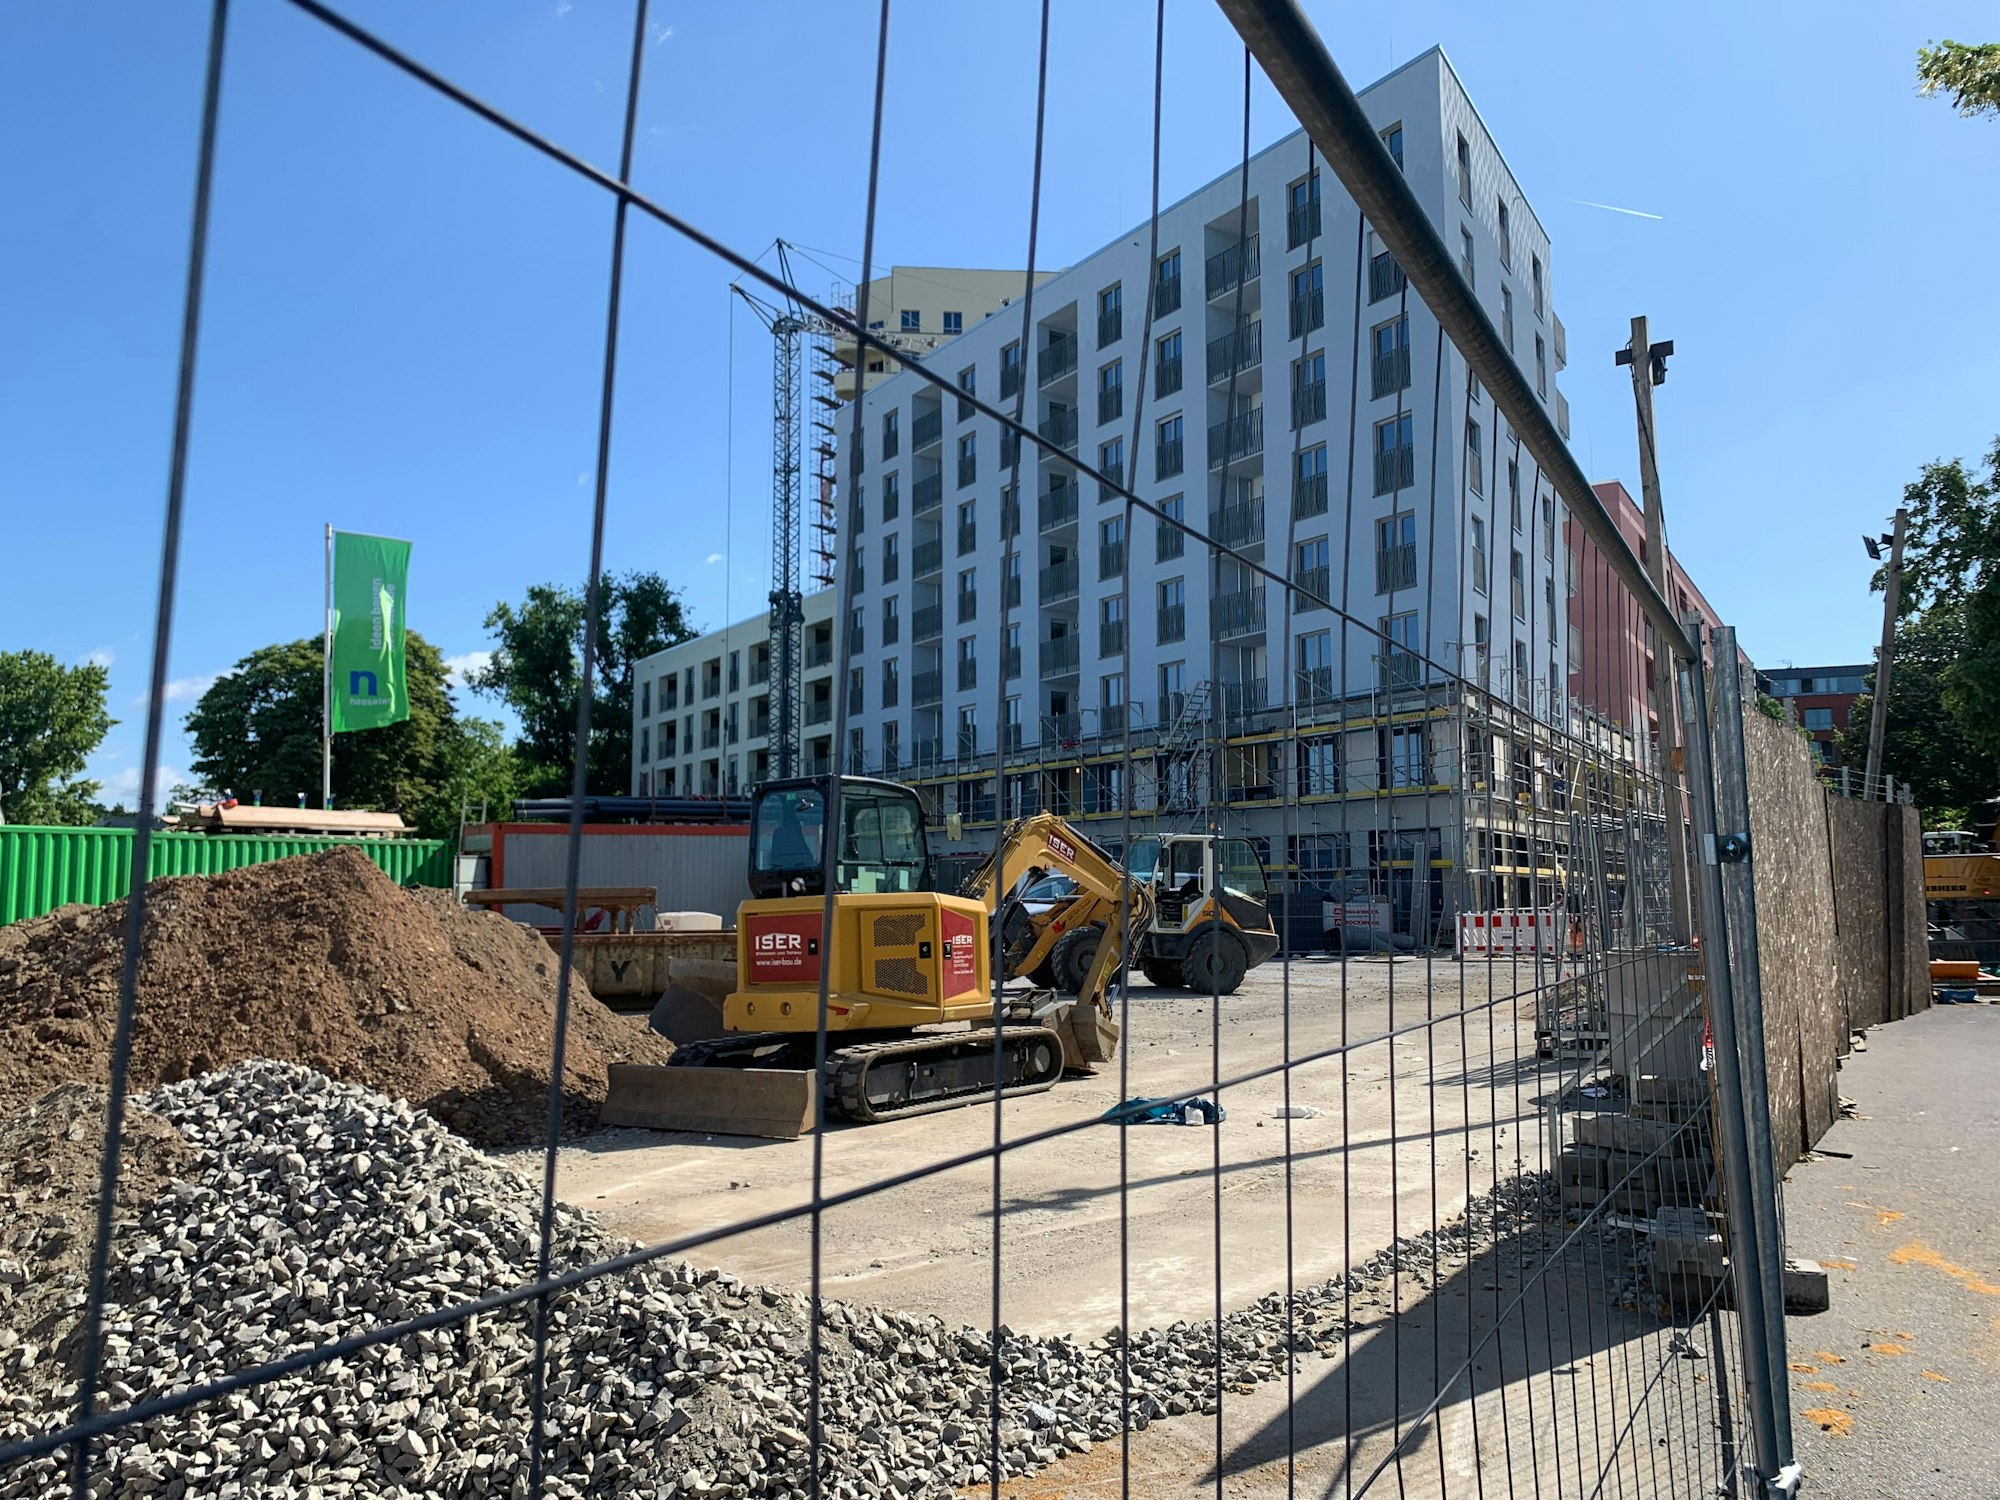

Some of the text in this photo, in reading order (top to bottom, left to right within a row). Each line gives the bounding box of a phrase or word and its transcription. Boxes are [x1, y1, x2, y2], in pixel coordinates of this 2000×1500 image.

[350, 670, 377, 697] n
[1048, 834, 1075, 860] ISER
[755, 933, 801, 950] ISER
[952, 934, 973, 945] ISER
